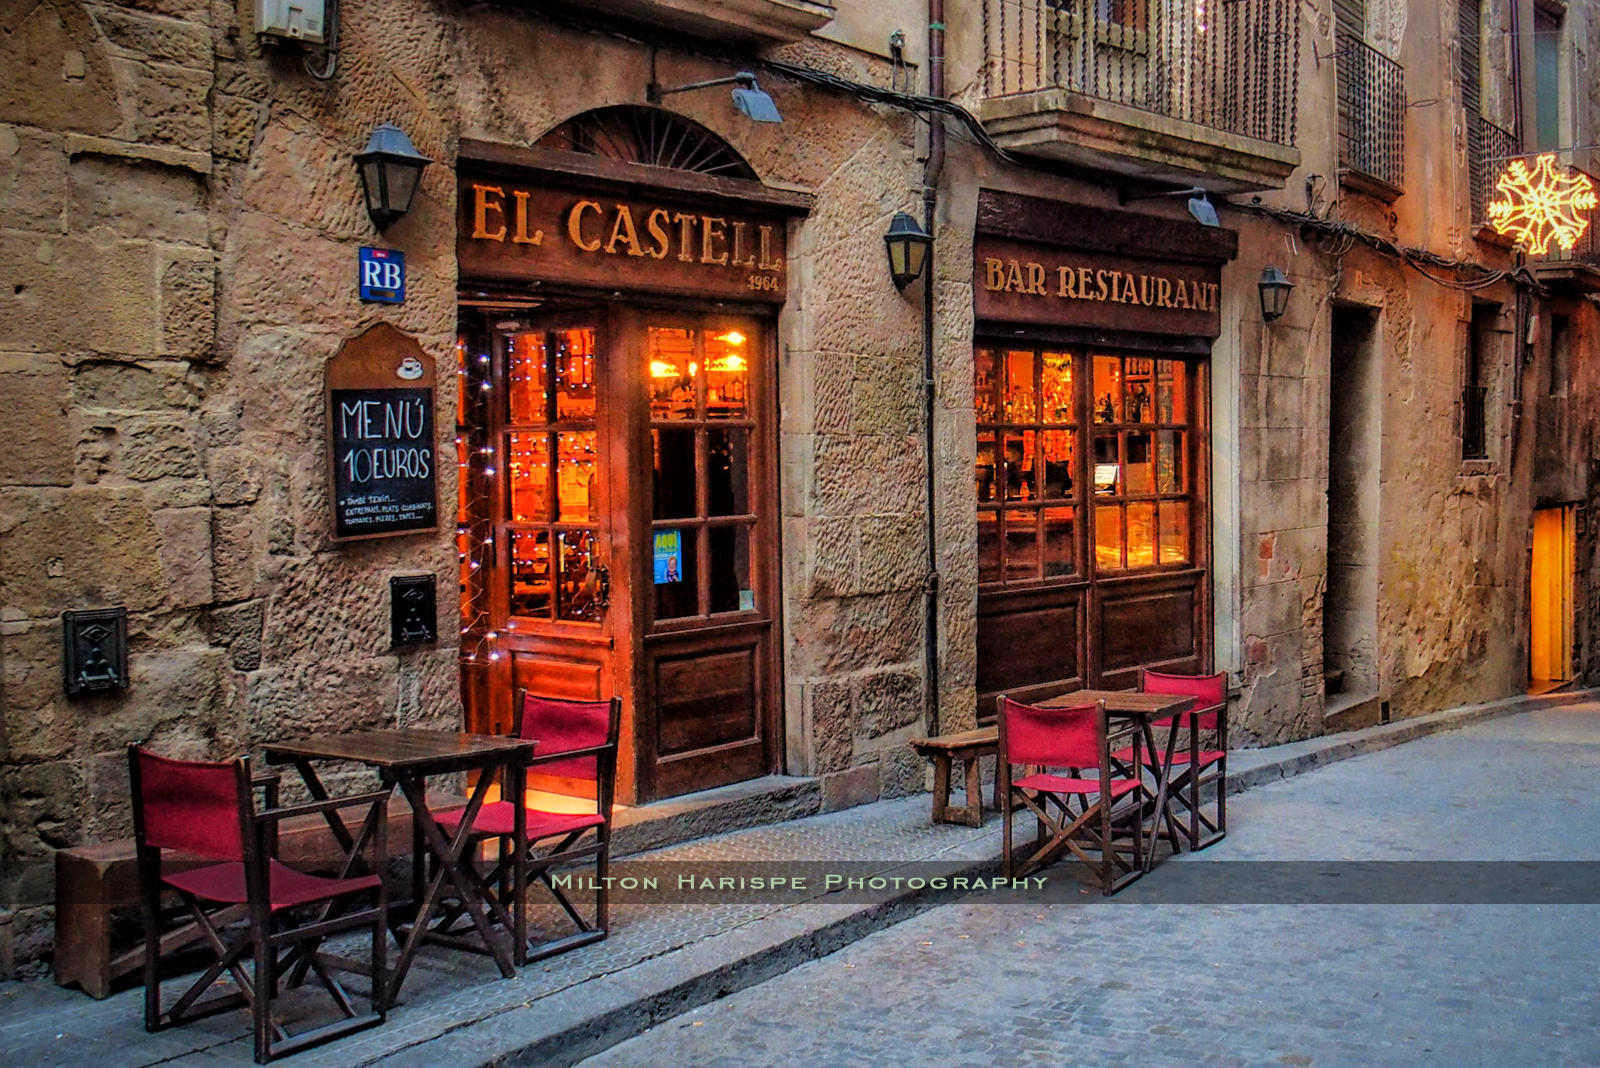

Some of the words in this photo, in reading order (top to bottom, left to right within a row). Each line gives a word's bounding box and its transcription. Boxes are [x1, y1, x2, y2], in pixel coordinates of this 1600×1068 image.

[472, 184, 544, 246] EL
[568, 199, 782, 271] CASTELL
[363, 260, 402, 289] RB
[748, 275, 779, 292] 1964
[984, 257, 1047, 296] BAR
[1057, 265, 1218, 313] RESTAURANT
[341, 398, 424, 439] MENÚ
